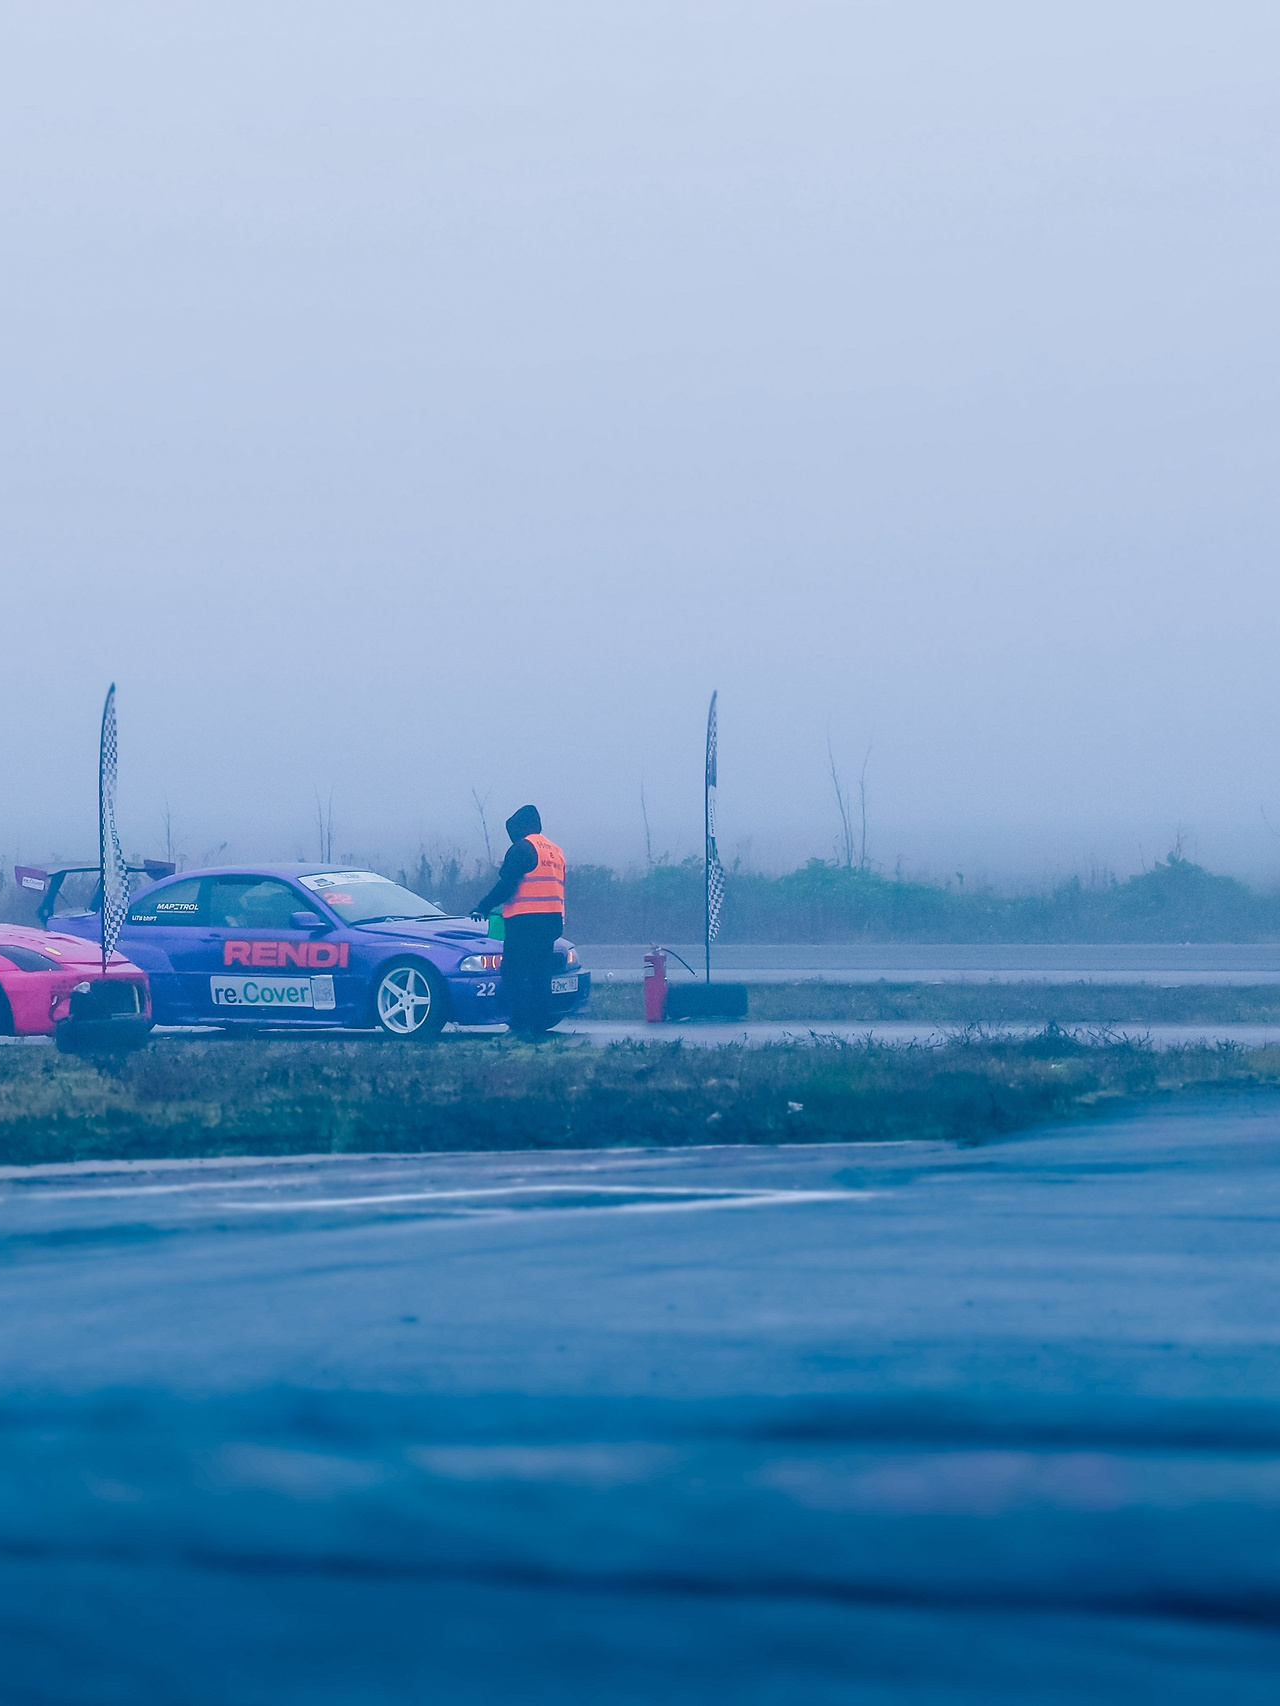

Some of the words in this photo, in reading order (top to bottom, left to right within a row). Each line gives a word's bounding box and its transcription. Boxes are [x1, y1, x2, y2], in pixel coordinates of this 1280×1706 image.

[323, 892, 355, 905] 22
[223, 940, 349, 968] RENDI
[214, 982, 309, 1004] re.Cover
[476, 982, 496, 996] 22
